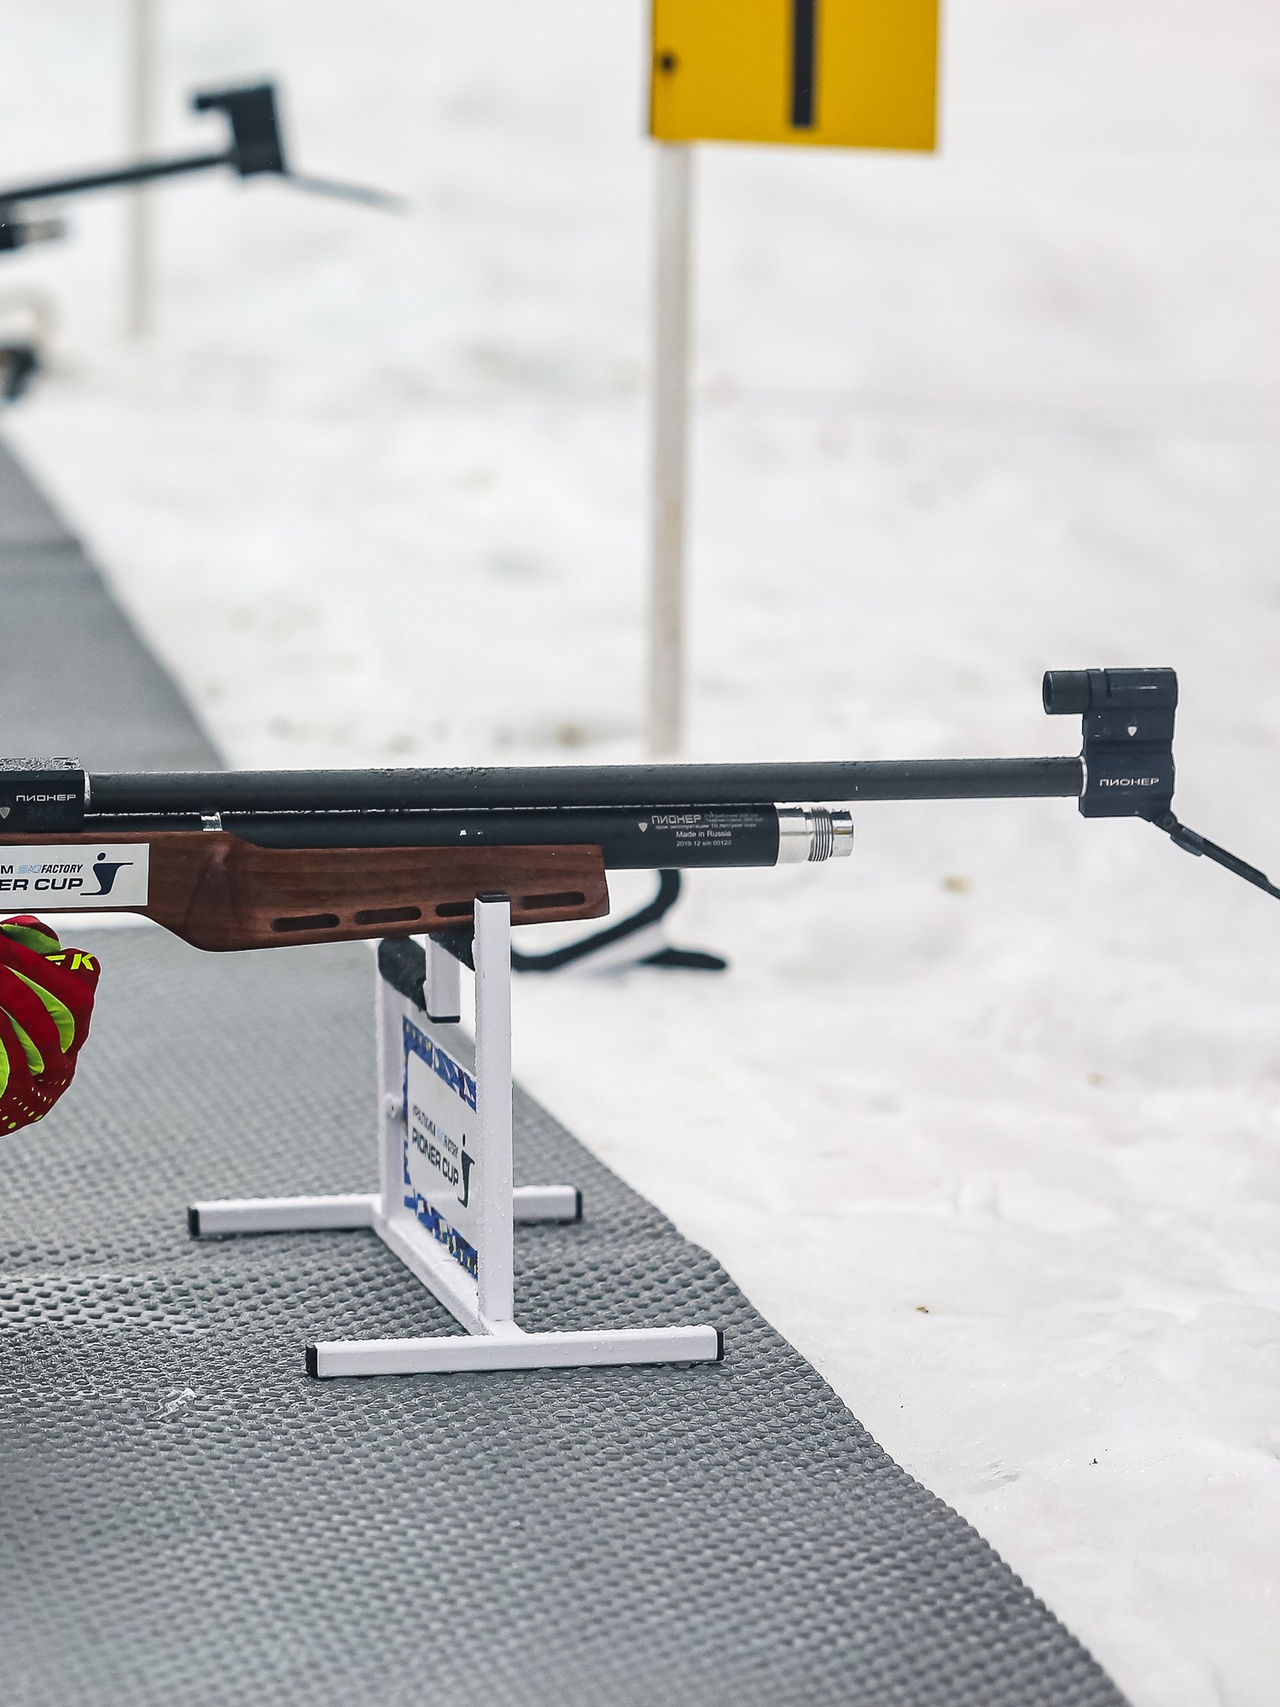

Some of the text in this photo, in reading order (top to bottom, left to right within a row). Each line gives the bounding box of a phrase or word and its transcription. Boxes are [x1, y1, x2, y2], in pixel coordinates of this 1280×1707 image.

[1099, 777, 1160, 787] ПИОНЕР
[15, 793, 77, 802] ПИОНЕР
[651, 814, 702, 824] ПИОНЕР
[34, 878, 83, 891] CUP
[411, 1126, 441, 1172] PIONER
[442, 1156, 460, 1187] CUP
